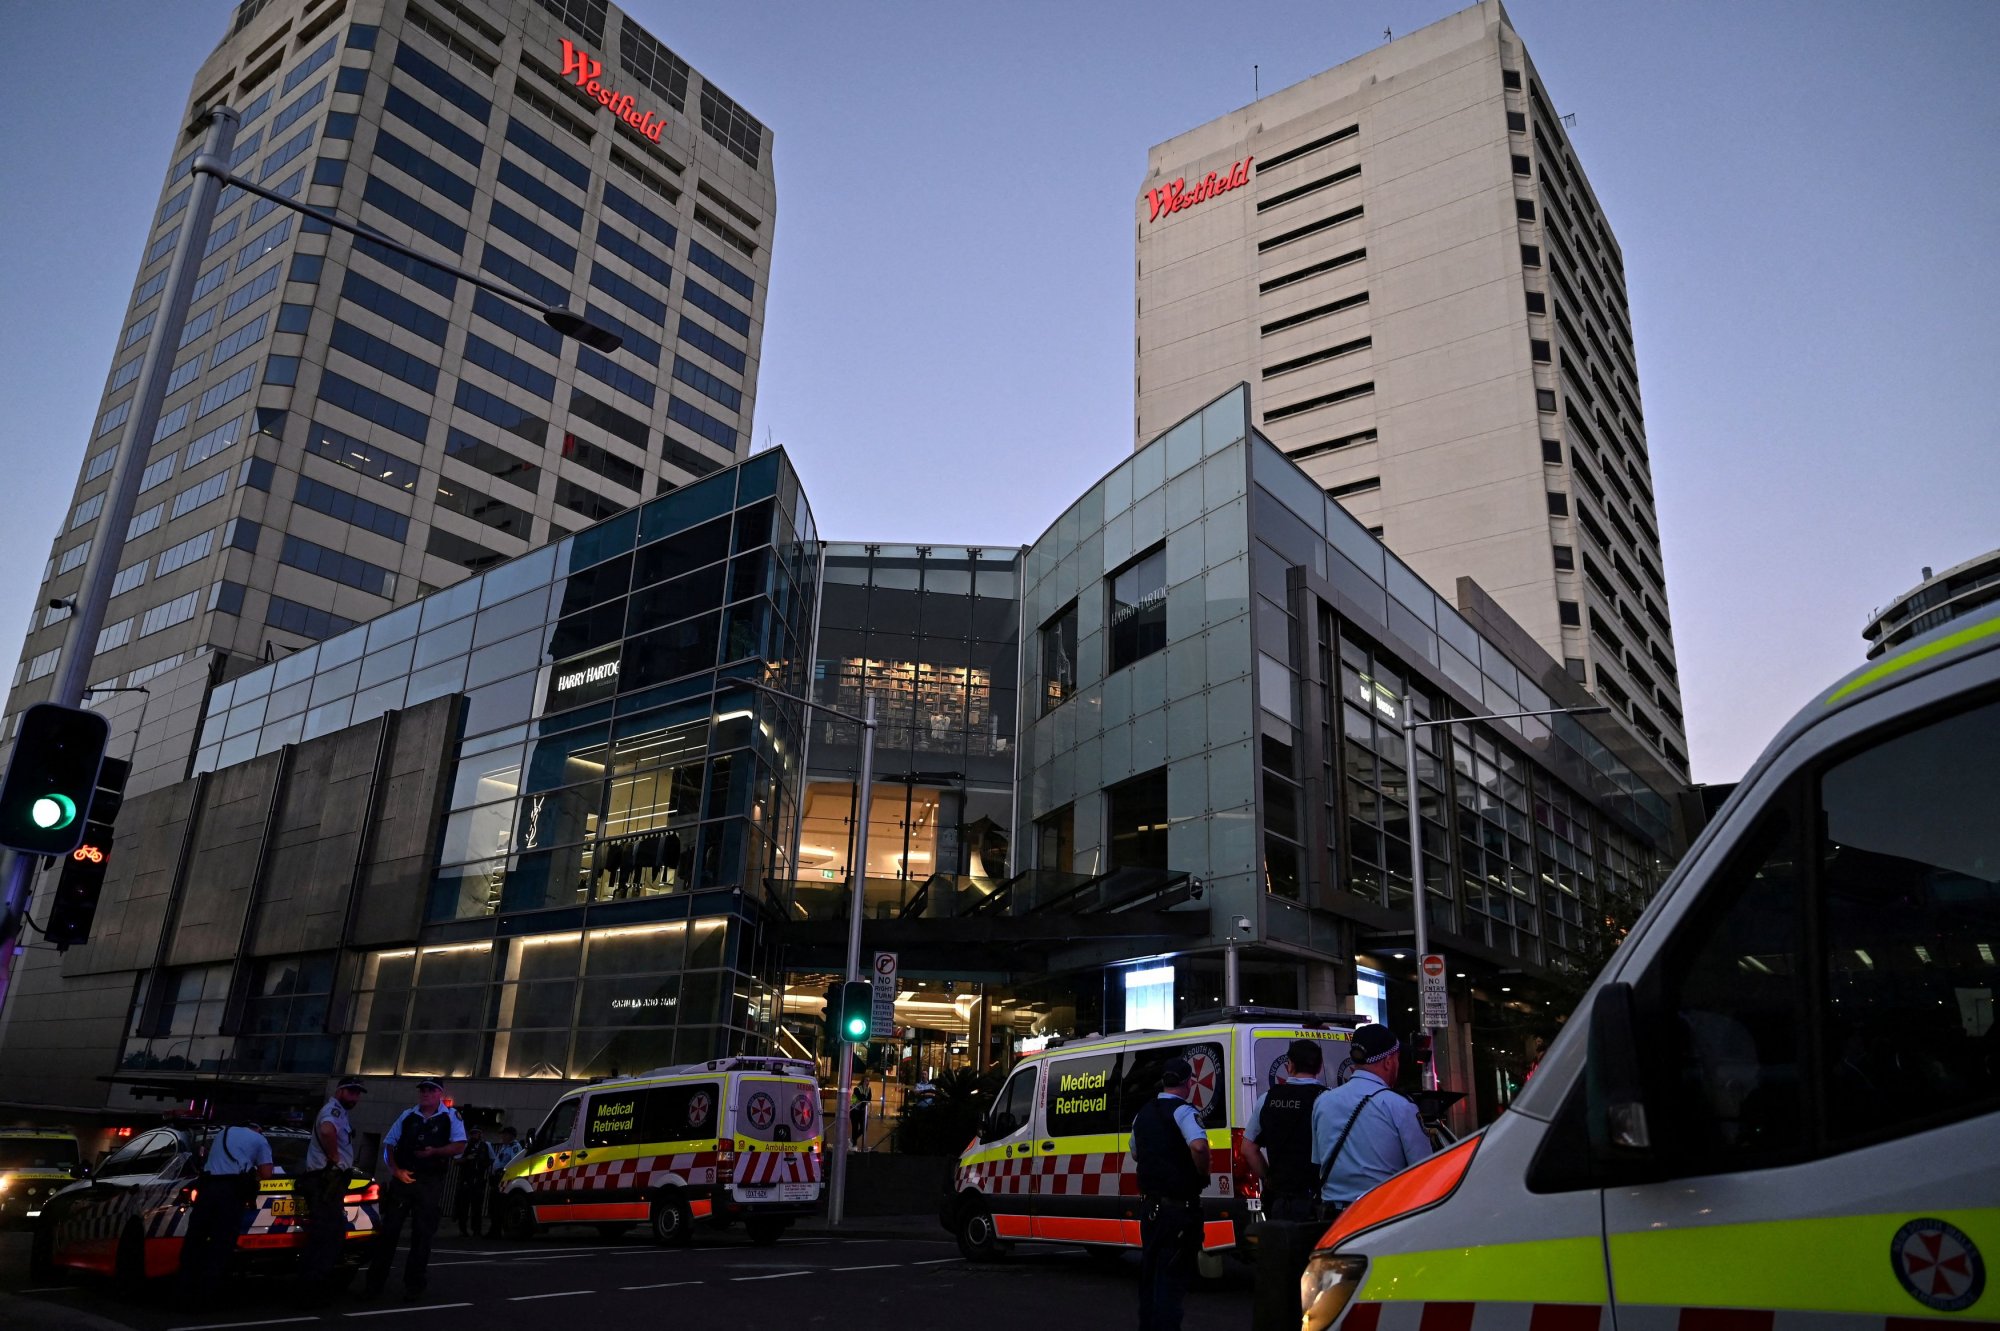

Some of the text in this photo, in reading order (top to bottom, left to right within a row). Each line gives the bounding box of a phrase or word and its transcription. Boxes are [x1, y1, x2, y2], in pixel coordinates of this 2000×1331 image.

[559, 37, 667, 144] Westfield
[1144, 156, 1254, 223] Westfield
[558, 670, 586, 691] HARRY
[878, 976, 891, 985] NO
[1294, 1031, 1340, 1040] PARAMEDIC
[1188, 1045, 1208, 1057] SOUTH
[1060, 1070, 1106, 1092] Medical
[597, 1101, 634, 1117] Medical
[1055, 1093, 1107, 1115] Retrieval
[1270, 1100, 1301, 1109] POLICE
[592, 1116, 634, 1133] Retrieval
[765, 1144, 798, 1152] Ambulance
